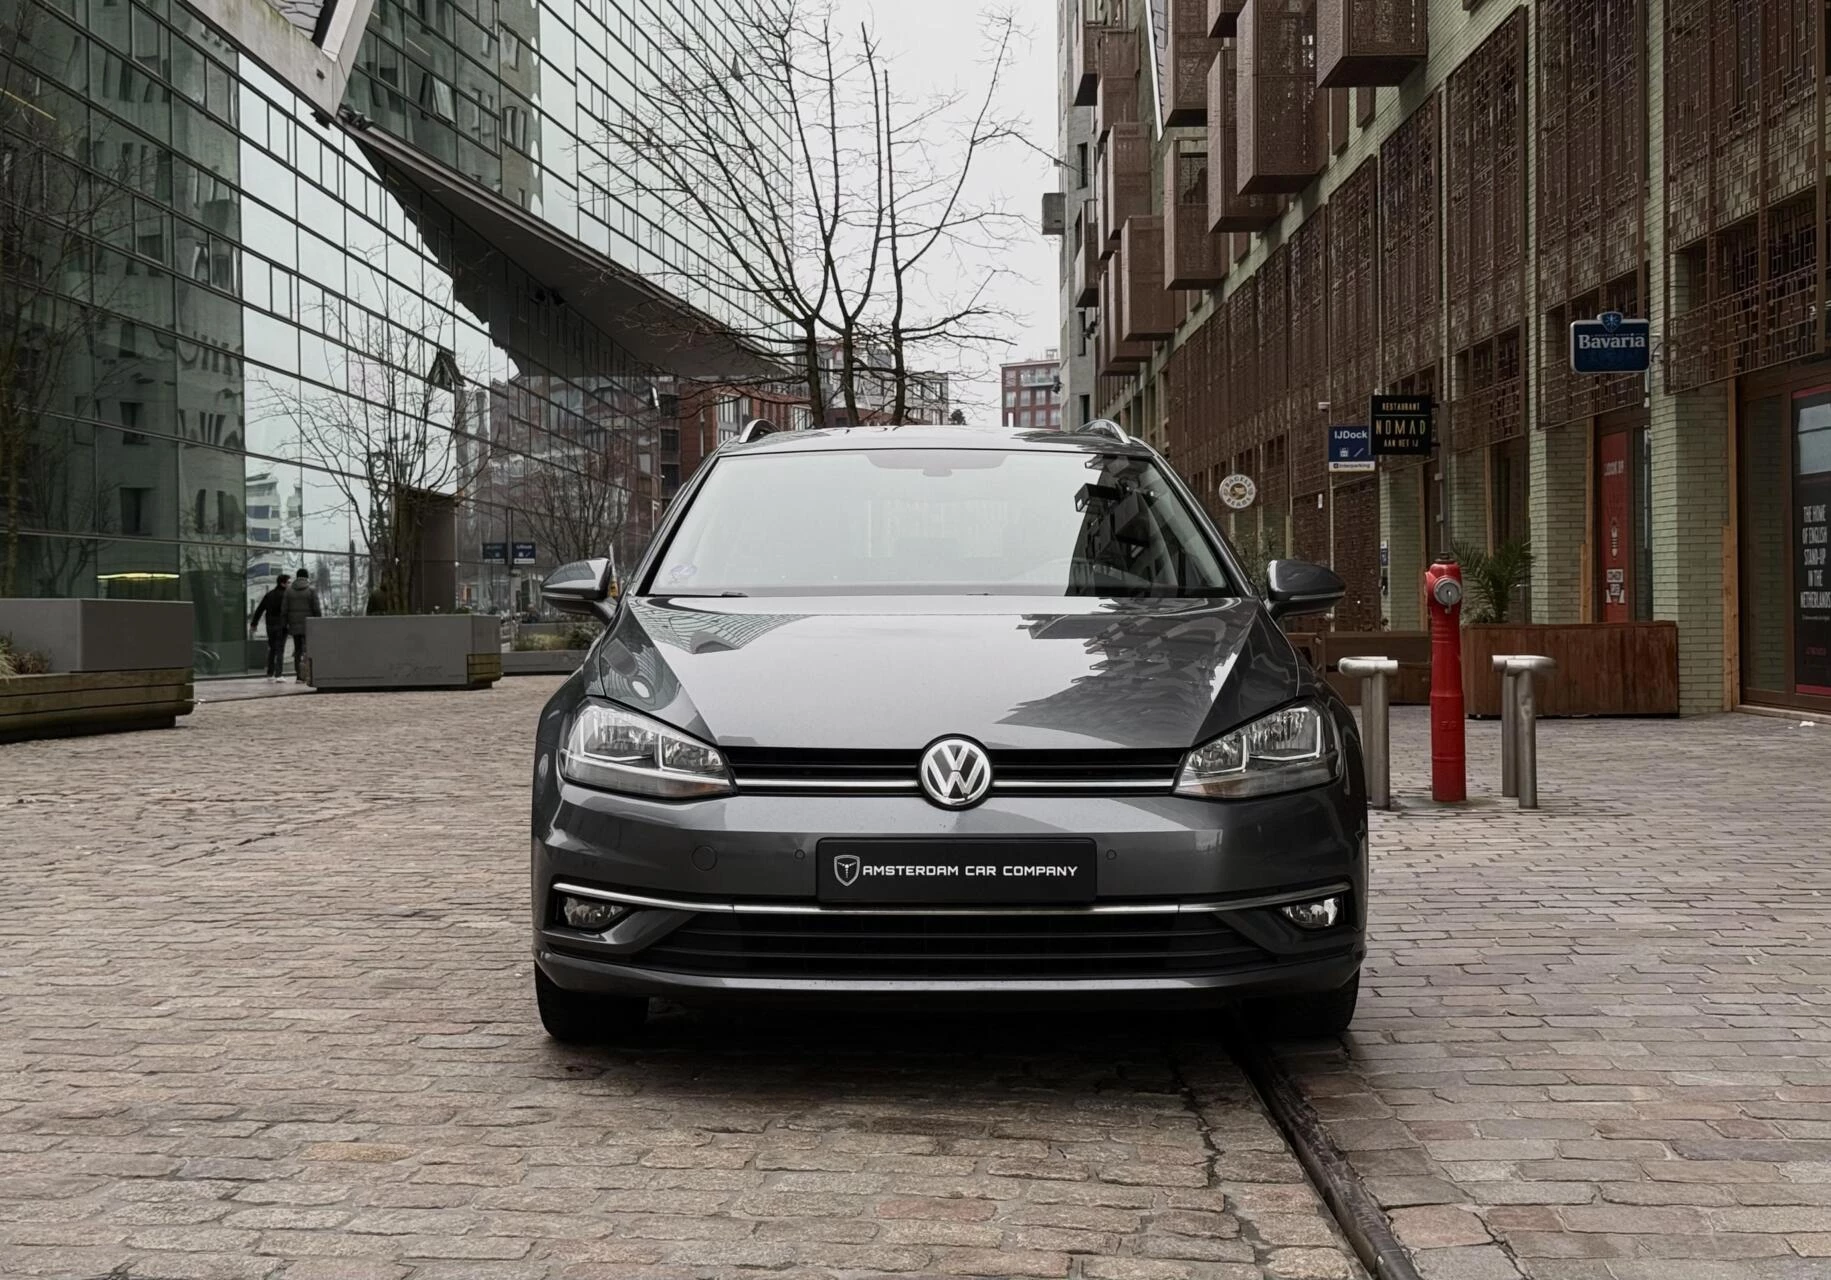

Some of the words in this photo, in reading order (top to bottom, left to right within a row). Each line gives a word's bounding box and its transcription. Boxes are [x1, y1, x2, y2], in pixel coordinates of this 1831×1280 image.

[1578, 333, 1646, 349] Bavaria
[1382, 402, 1420, 411] RESTAURANT
[1375, 419, 1426, 435] NOMAD
[1334, 430, 1368, 439] IJDock
[862, 865, 959, 876] AMSTERDAM
[965, 865, 997, 876] CAR
[1003, 865, 1078, 876] COMPANY
